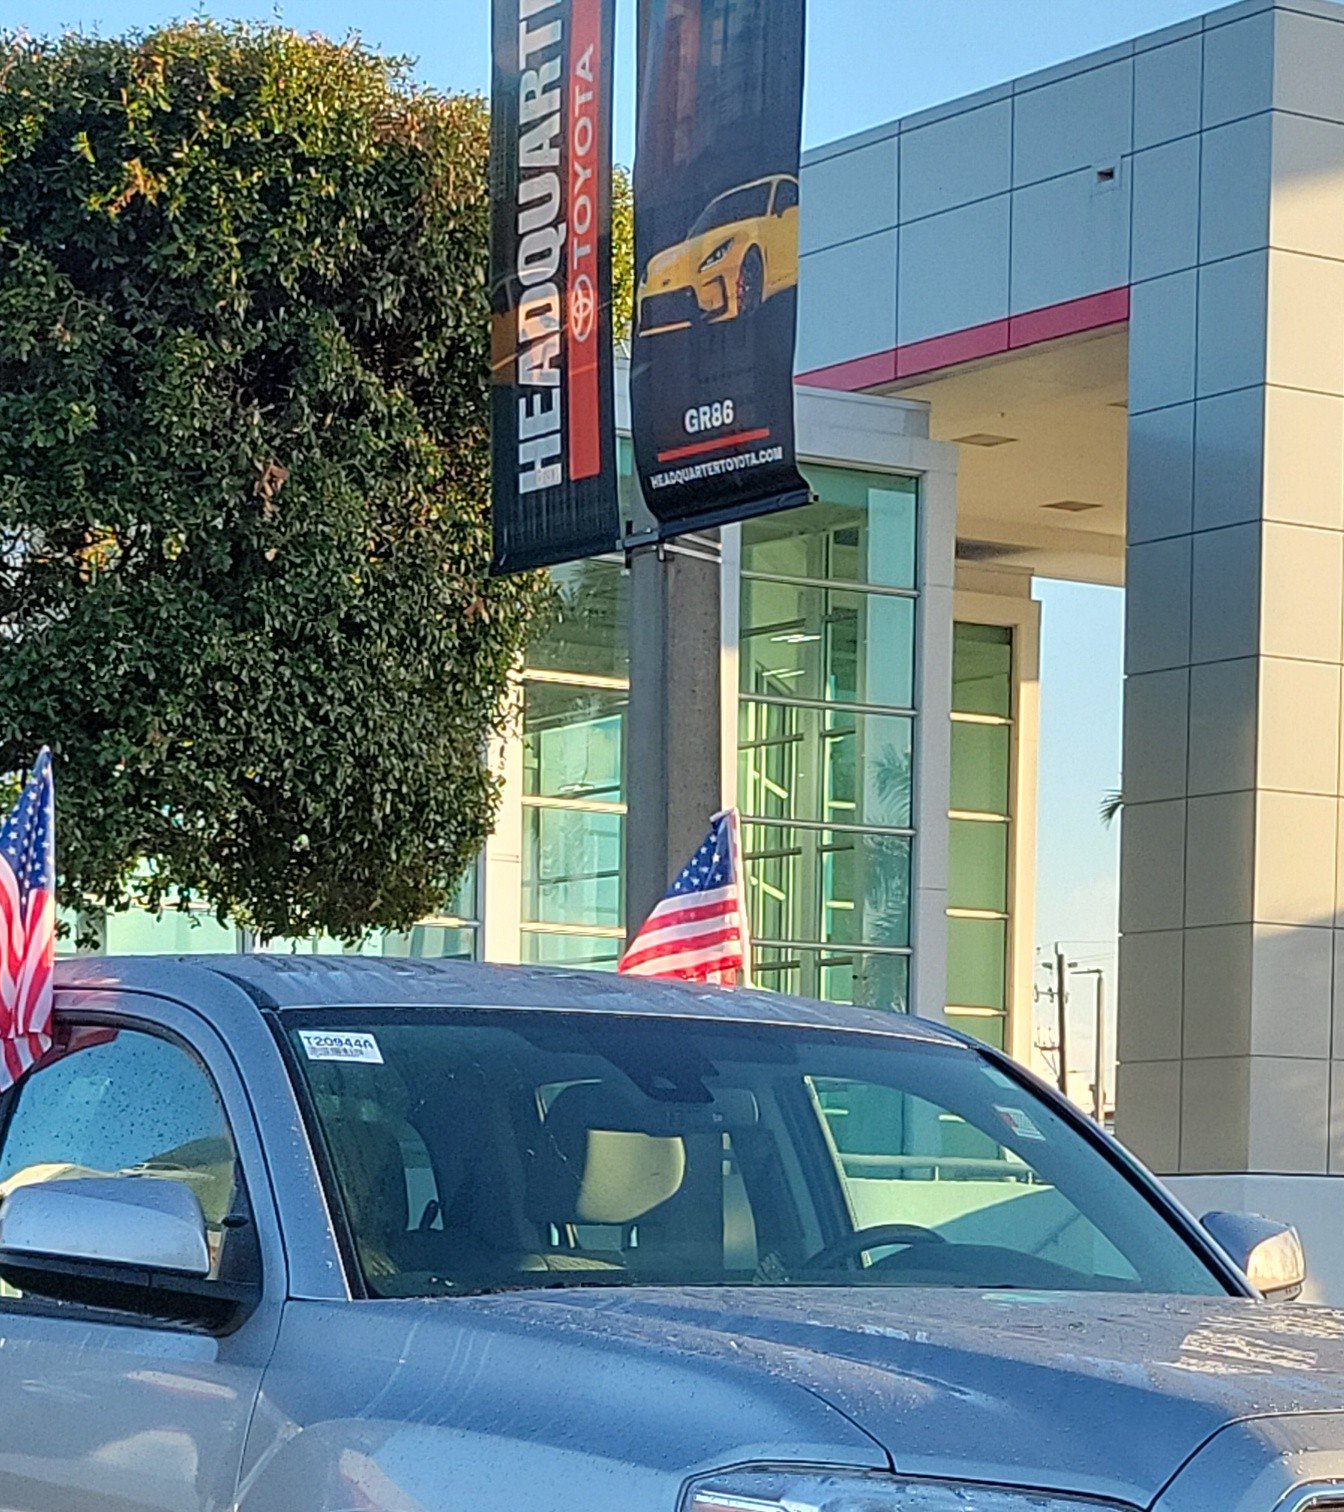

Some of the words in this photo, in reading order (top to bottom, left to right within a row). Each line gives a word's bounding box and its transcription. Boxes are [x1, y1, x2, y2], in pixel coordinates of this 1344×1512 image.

[571, 43, 595, 270] TOYOTA
[684, 399, 734, 434] GR86
[649, 446, 783, 489] HEADQUARTERTOYOTA.COM
